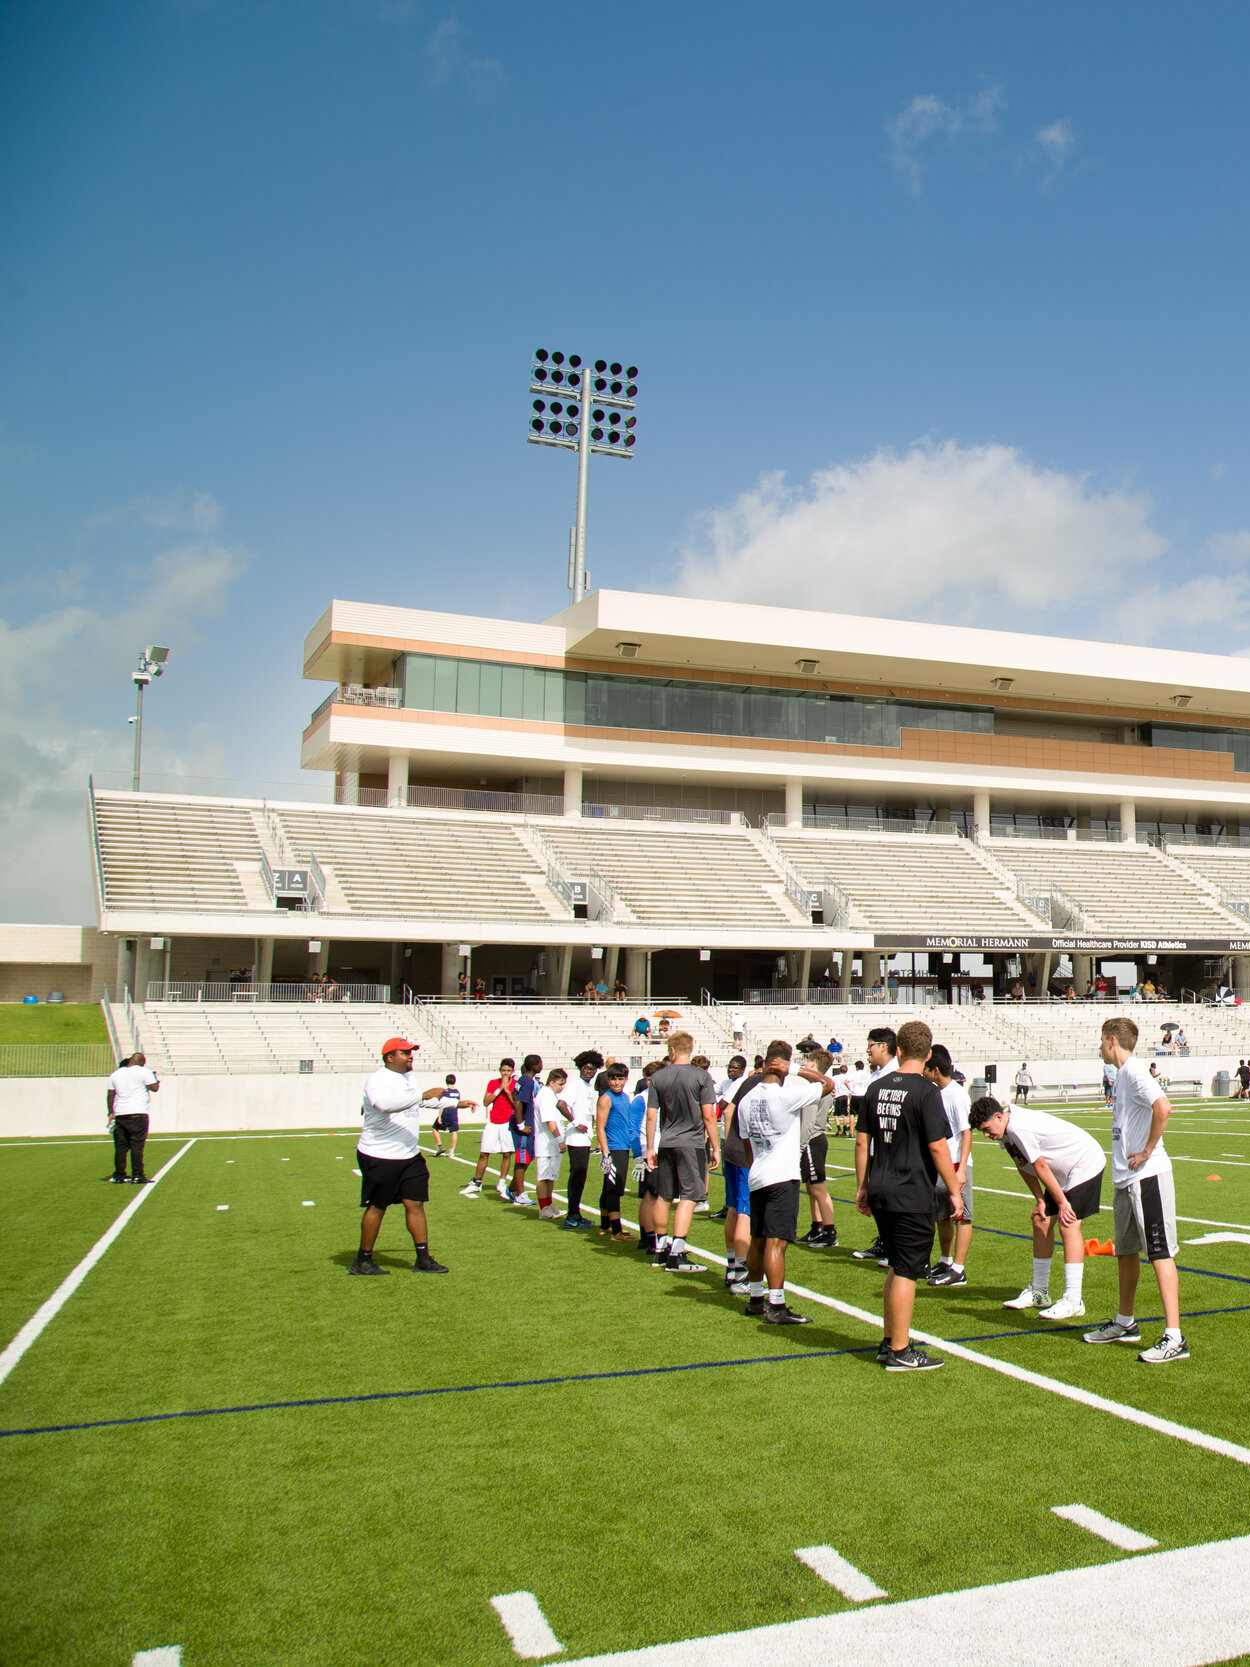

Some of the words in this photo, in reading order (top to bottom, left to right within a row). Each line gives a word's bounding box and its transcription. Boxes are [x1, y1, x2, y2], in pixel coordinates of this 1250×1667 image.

[292, 873, 302, 882] A
[574, 885, 581, 893] B
[926, 937, 978, 947] MEMORIAL
[981, 938, 1029, 947] HERMANN
[1052, 939, 1075, 948] Official
[1077, 940, 1112, 948] Healthcare
[1113, 940, 1139, 949] Provider
[1140, 941, 1156, 949] KISD
[1158, 941, 1187, 949] Athletics
[878, 1088, 908, 1103] VICTORY
[876, 1102, 902, 1117] BEGINS
